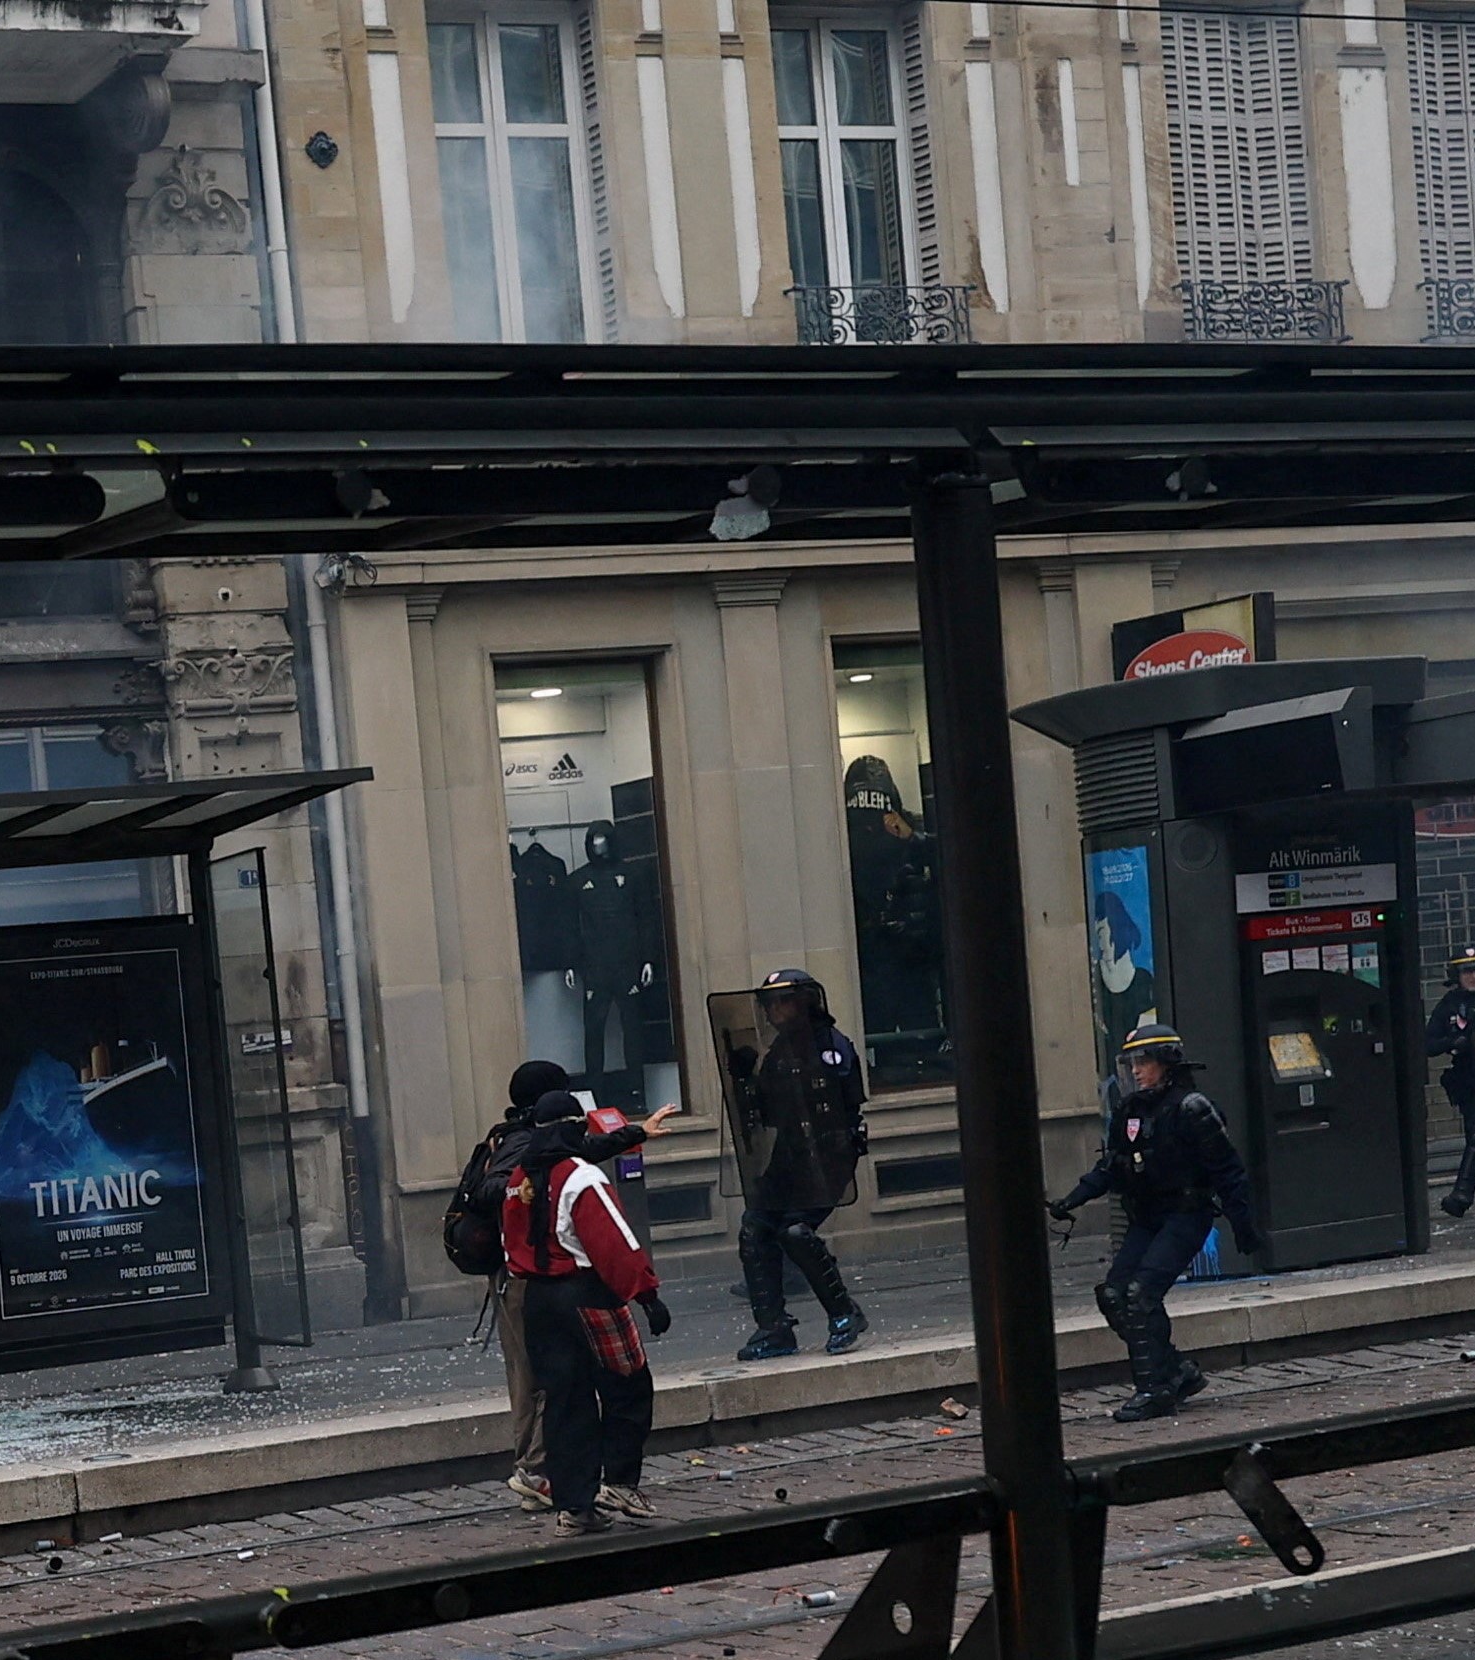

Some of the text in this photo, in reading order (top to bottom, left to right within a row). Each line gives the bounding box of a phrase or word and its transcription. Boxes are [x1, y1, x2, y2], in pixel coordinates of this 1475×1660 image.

[1133, 646, 1247, 678] Shops Center
[515, 763, 538, 774] asics
[548, 769, 584, 781] adidas
[1269, 845, 1362, 868] Alt Winmärik
[1288, 874, 1296, 888] B
[1289, 892, 1297, 905] F
[29, 1169, 162, 1218] TITANIC
[56, 1221, 144, 1243] UN VOYAGE IMMERSIF
[155, 1248, 196, 1263] HALL TIVOLI
[16, 1270, 48, 1285] OCTOBRE
[49, 1268, 68, 1282] 2026
[119, 1260, 197, 1280] PARC DES EXPOSITIONS
